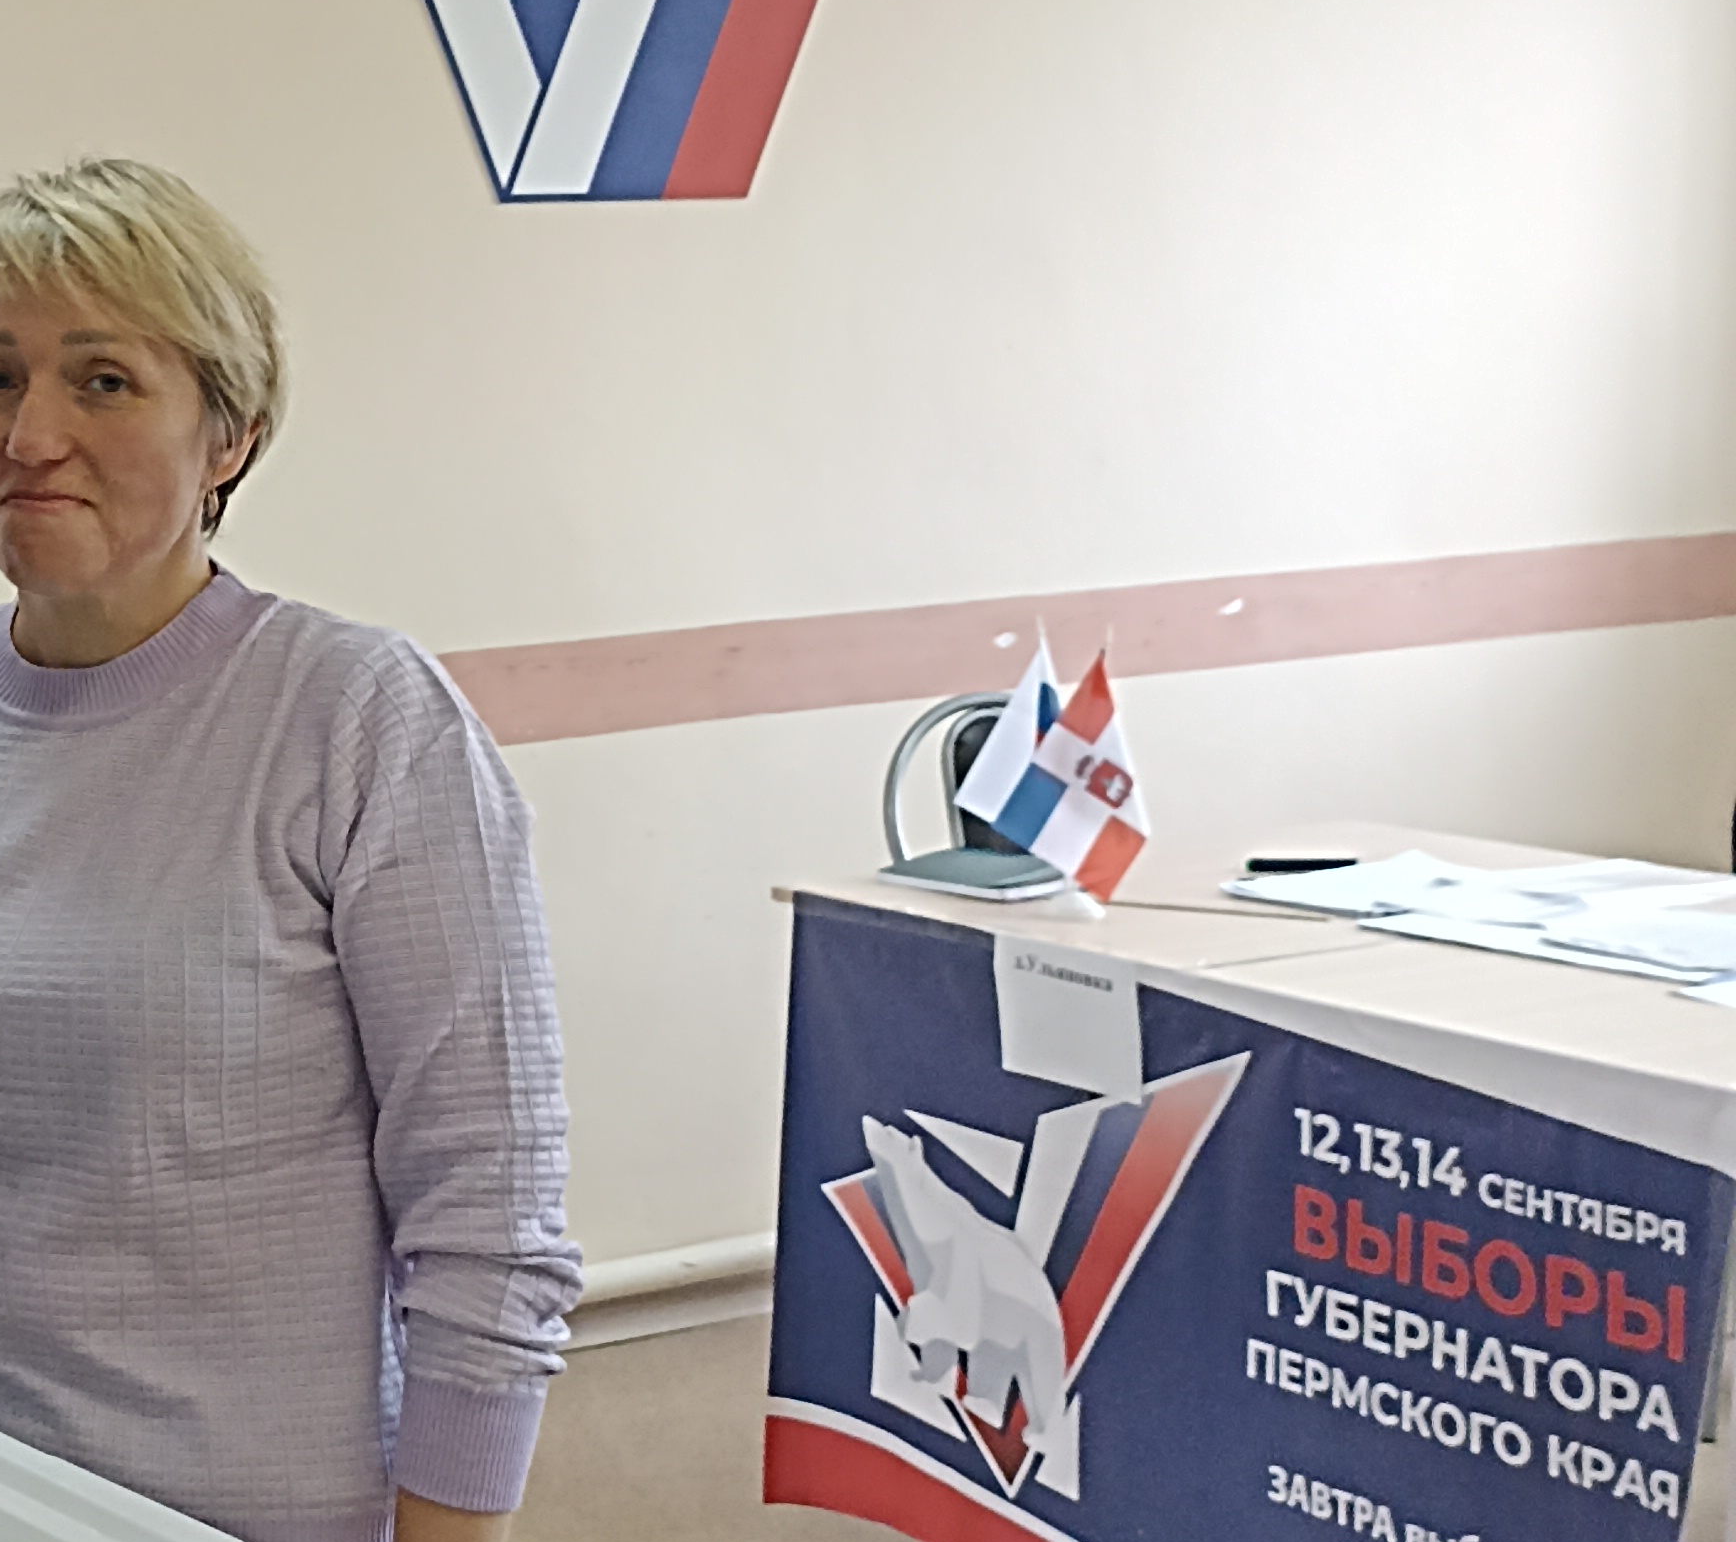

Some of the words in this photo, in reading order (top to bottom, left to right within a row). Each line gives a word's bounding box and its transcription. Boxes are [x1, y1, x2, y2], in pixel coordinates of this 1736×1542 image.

[1293, 1107, 1467, 1196] 12,13,14
[1478, 1172, 1687, 1256] СЕНТЯБРЯ
[1266, 1269, 1681, 1443] ГУБЕРНАТОРА
[1292, 1183, 1687, 1363] ВЫБОРЫ
[1246, 1338, 1532, 1467] ПЕРМСКОГО
[1547, 1434, 1680, 1519] КРАЯ
